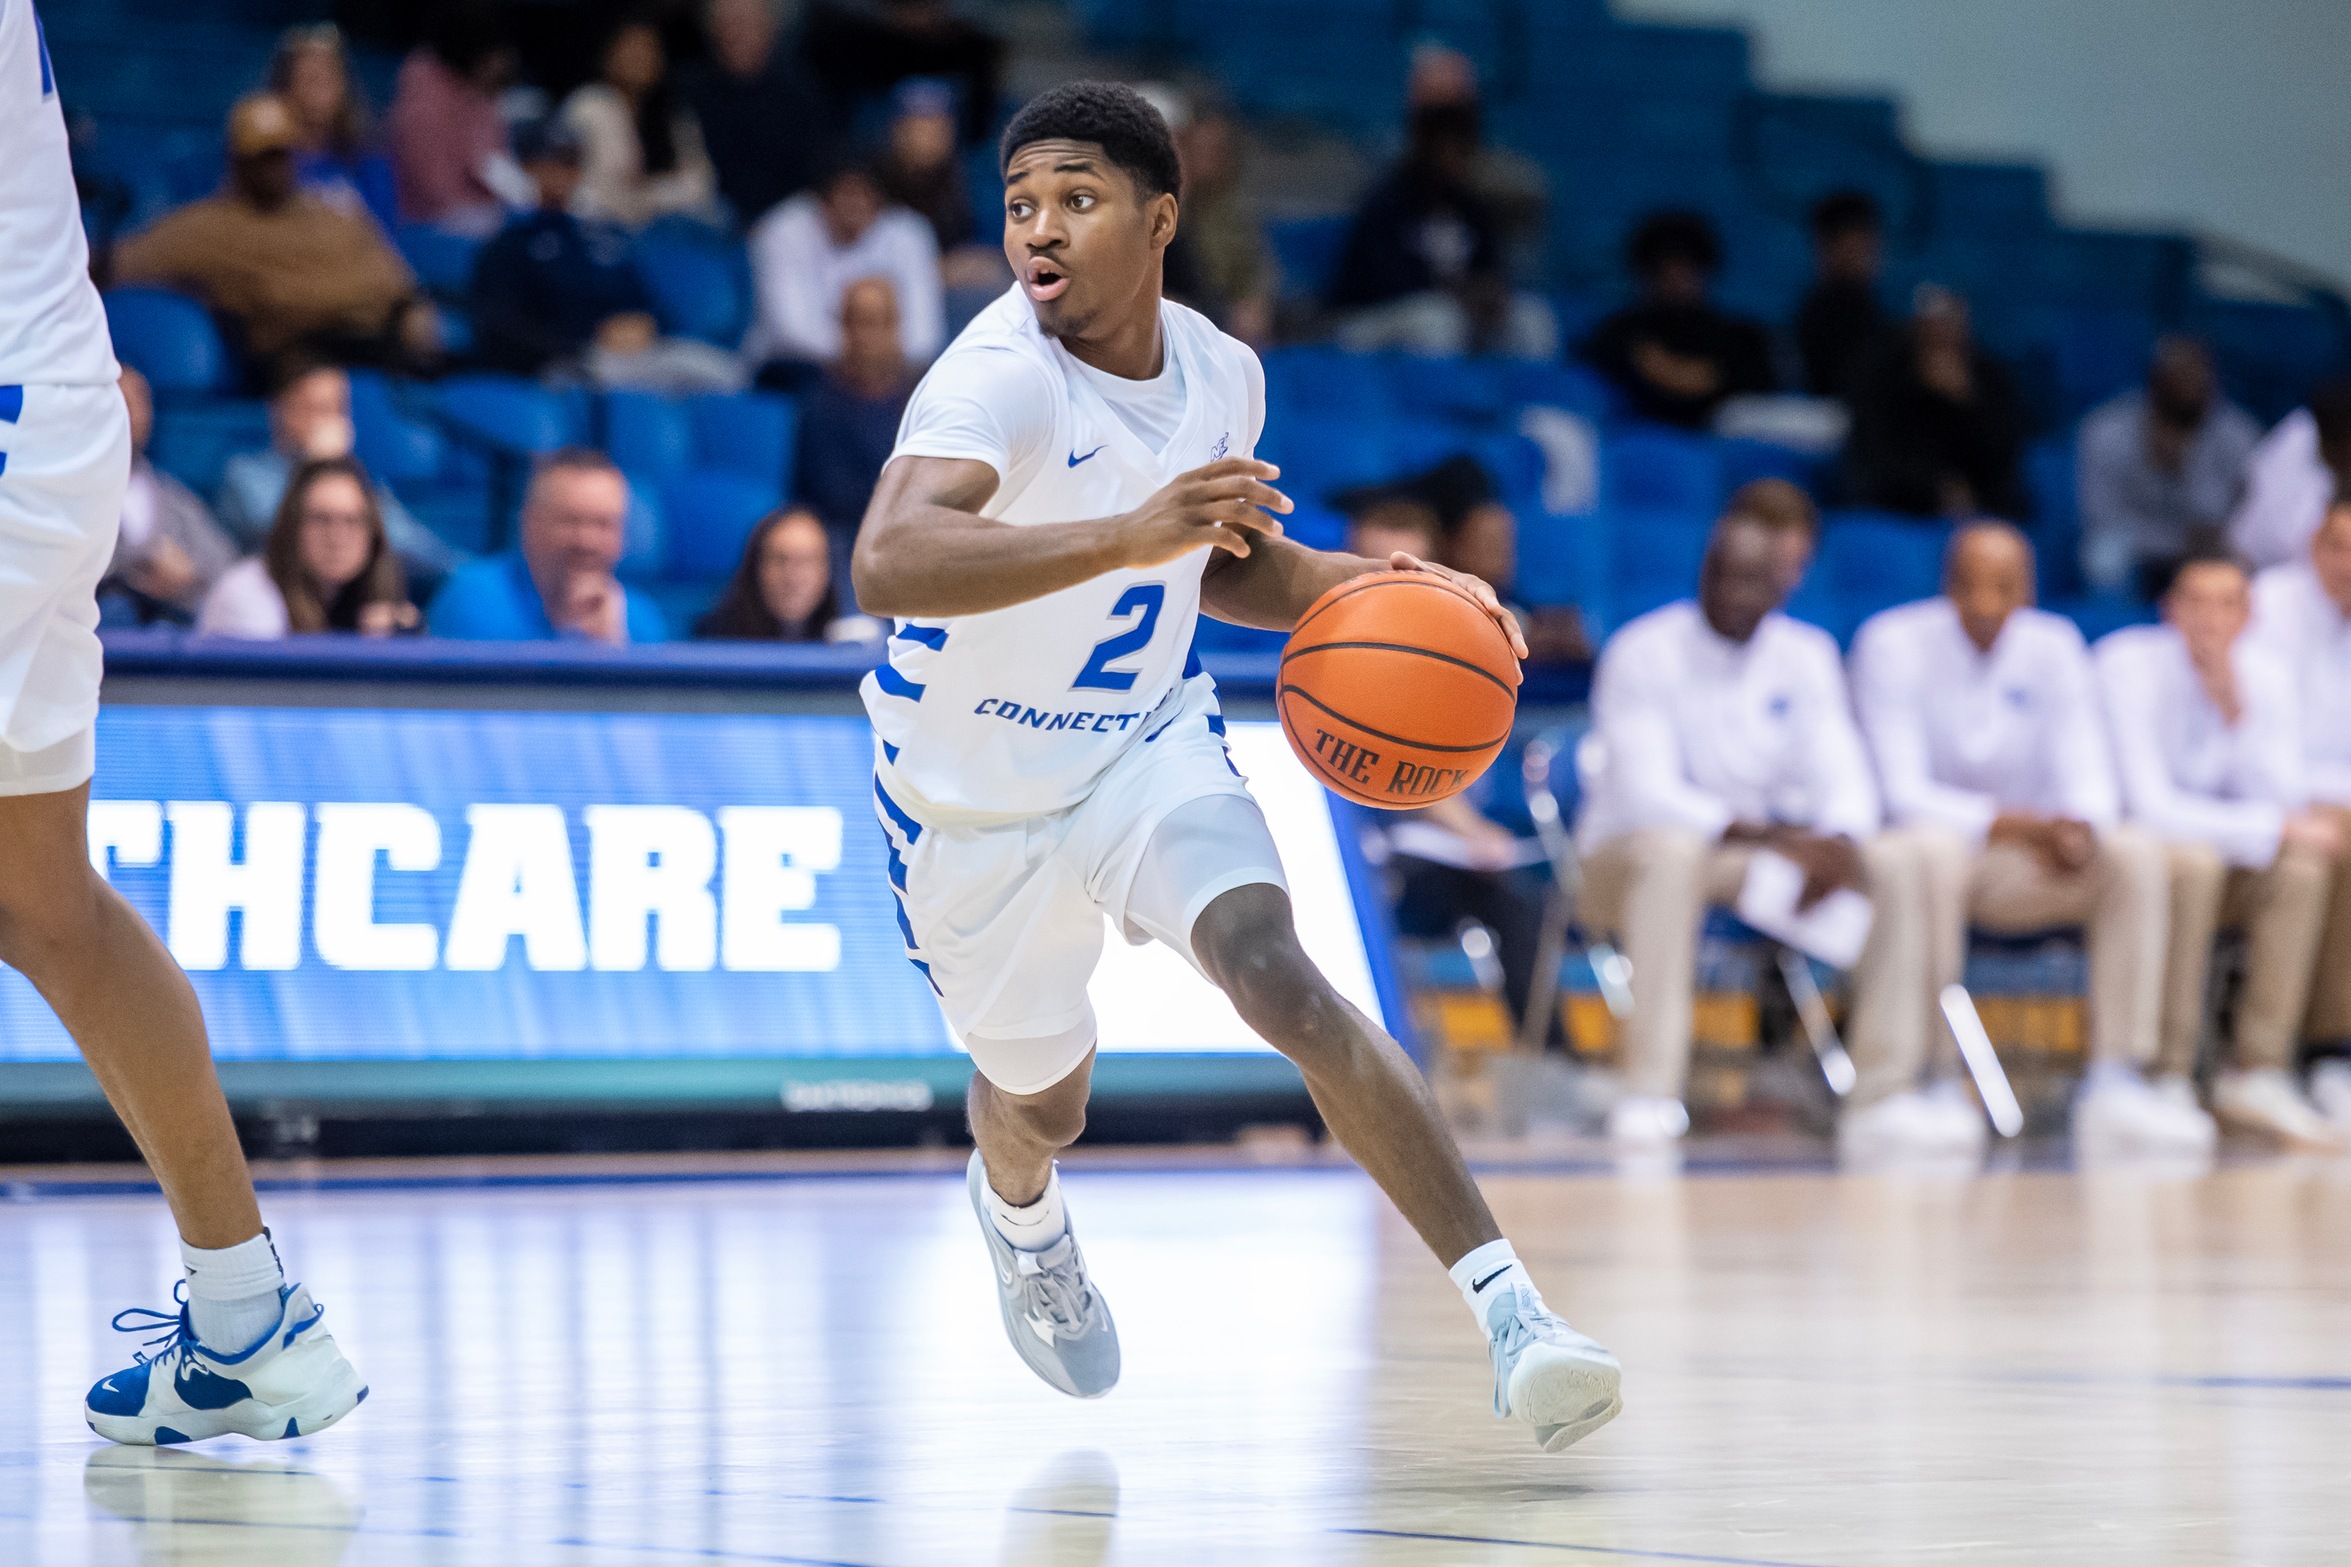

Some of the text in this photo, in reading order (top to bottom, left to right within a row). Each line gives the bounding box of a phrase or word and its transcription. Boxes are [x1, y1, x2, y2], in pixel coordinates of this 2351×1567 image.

[1067, 580, 1167, 694] 2
[1316, 728, 1470, 796] THE ROCK
